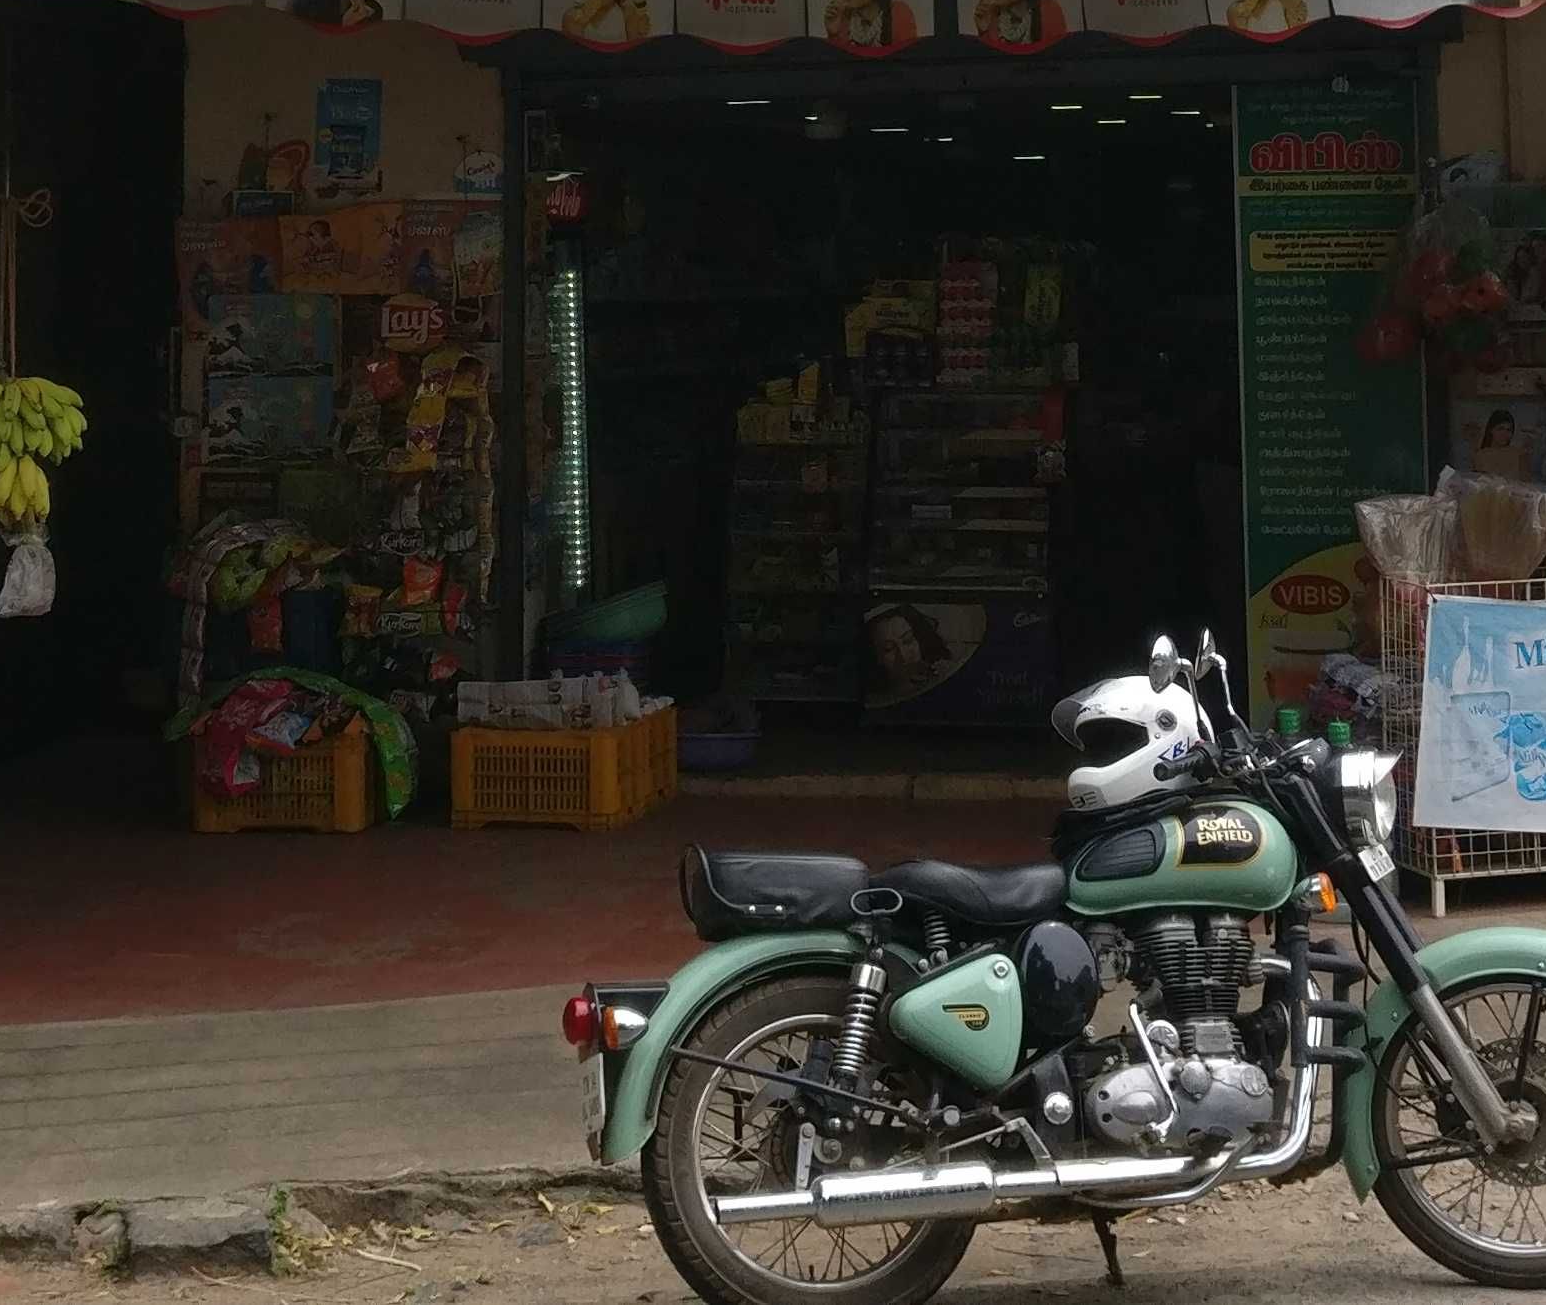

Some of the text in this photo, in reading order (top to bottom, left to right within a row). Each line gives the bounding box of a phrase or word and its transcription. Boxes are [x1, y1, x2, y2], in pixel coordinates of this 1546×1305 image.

[380, 301, 444, 344] Lay's
[1279, 584, 1342, 607] VIBIS
[1197, 817, 1246, 831] ROYAL
[1197, 830, 1253, 845] ENFIELD
